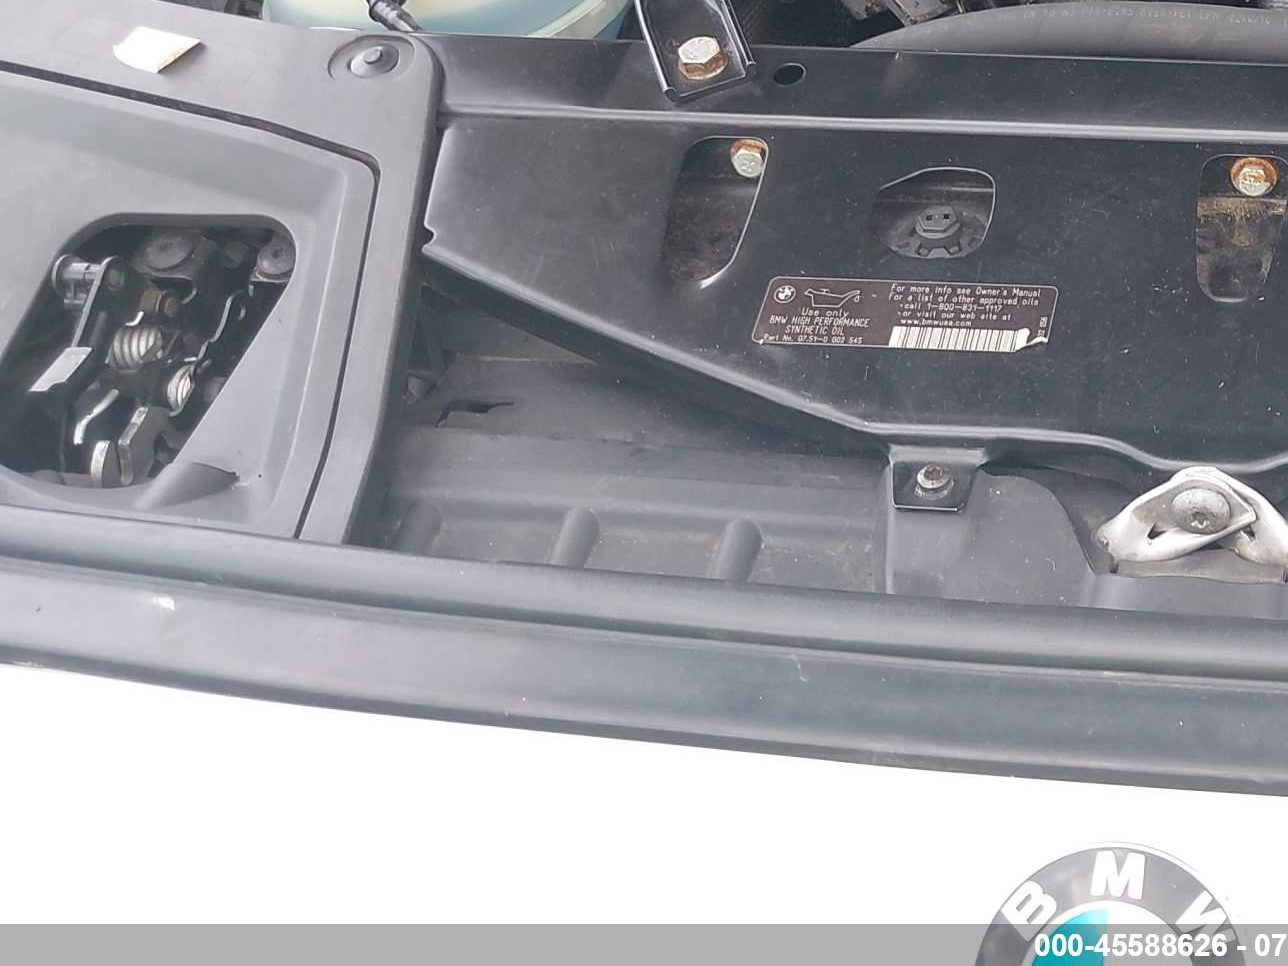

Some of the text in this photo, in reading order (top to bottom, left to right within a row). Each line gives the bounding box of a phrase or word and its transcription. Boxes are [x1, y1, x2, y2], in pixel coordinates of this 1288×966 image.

[890, 283, 906, 293] For
[910, 286, 930, 294] more
[935, 285, 952, 294] info
[976, 286, 1008, 296] Owner's
[1012, 287, 1041, 297] Manual
[888, 291, 903, 301] For
[917, 293, 934, 302] list
[937, 294, 948, 303] of
[952, 294, 975, 304] other
[980, 297, 1019, 305] approved
[1022, 297, 1039, 306] oils
[801, 307, 849, 319] Use only
[917, 310, 937, 319] visit
[960, 311, 976, 320] web
[980, 312, 998, 321] site
[1002, 313, 1012, 321] at
[769, 315, 871, 328] BMW HIGH PERFORMANCE
[900, 318, 972, 327] www.bmwusa.com
[785, 324, 846, 336] SYNTHETIC OIL
